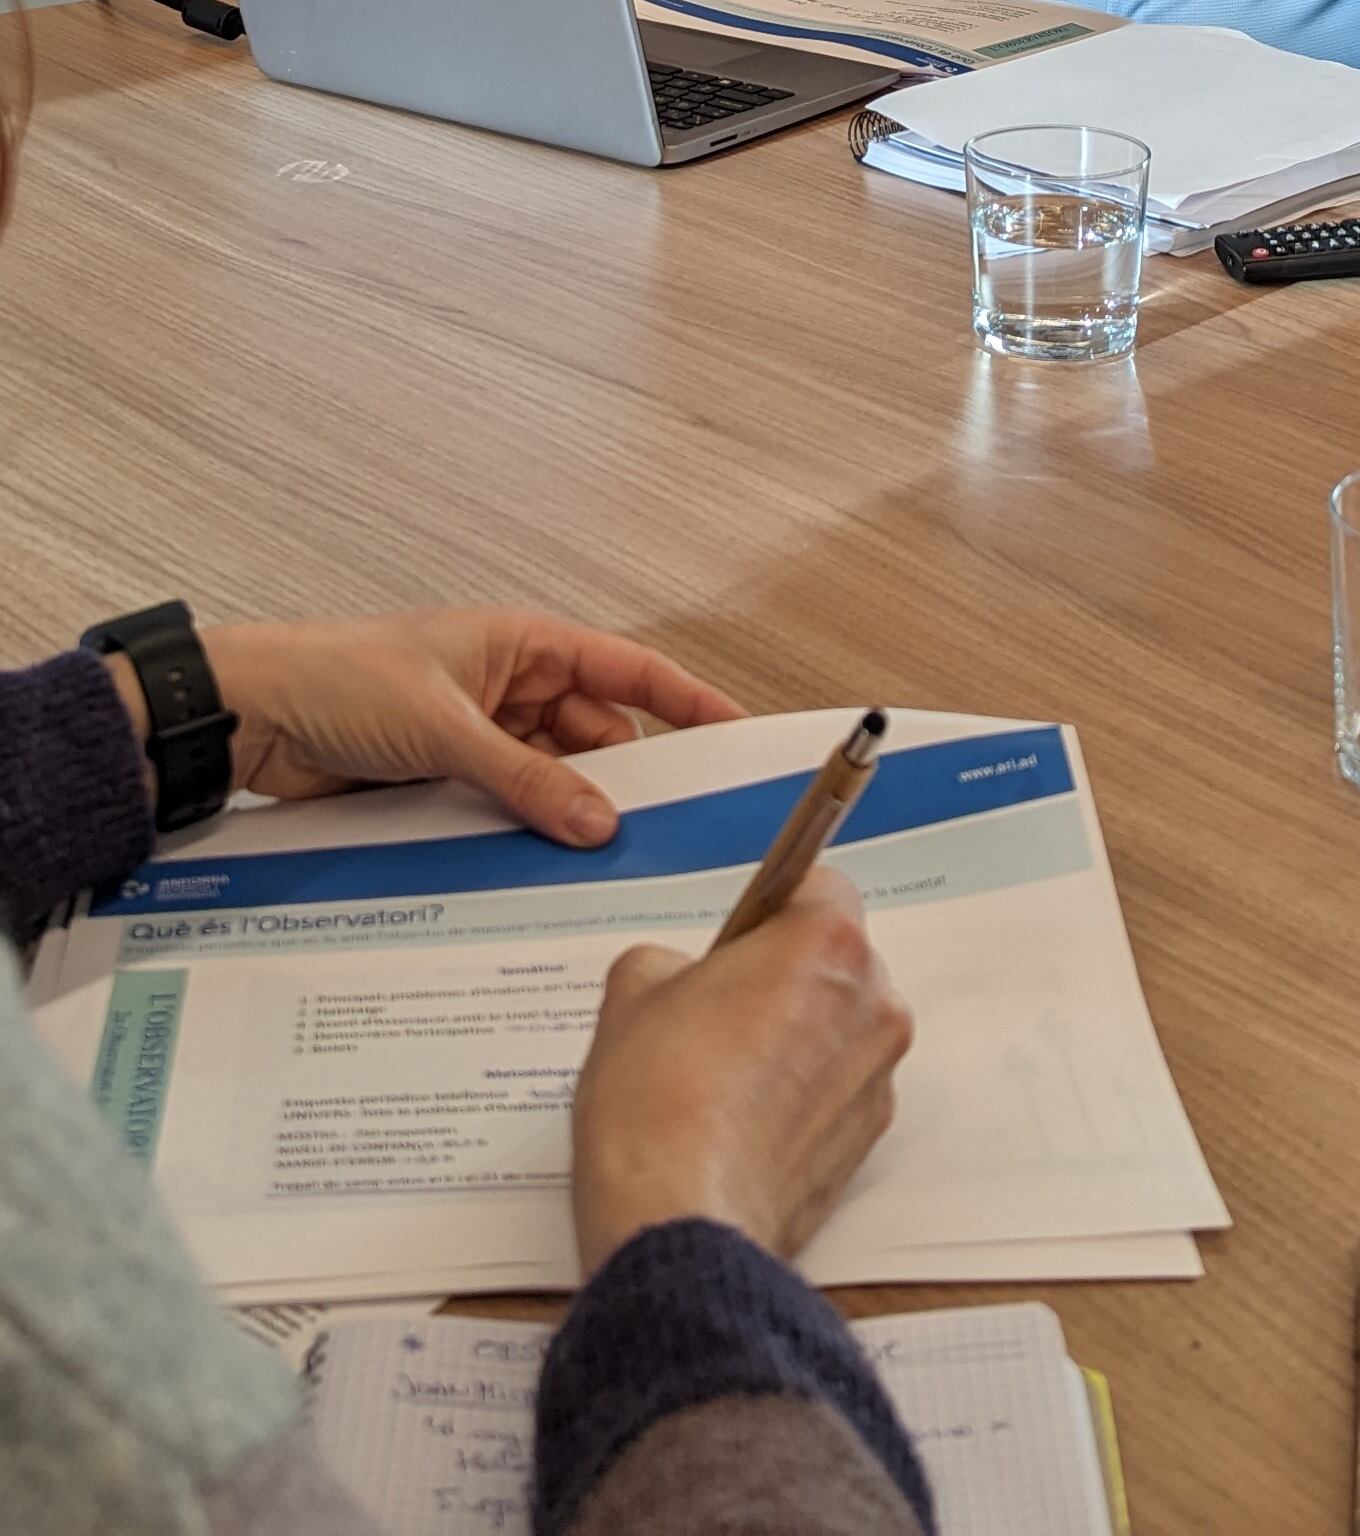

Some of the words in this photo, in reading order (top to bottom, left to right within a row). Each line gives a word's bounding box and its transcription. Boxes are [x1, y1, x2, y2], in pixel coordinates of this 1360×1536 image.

[957, 751, 1038, 783] www.ari.ad
[130, 919, 191, 941] Què
[198, 917, 232, 937] és
